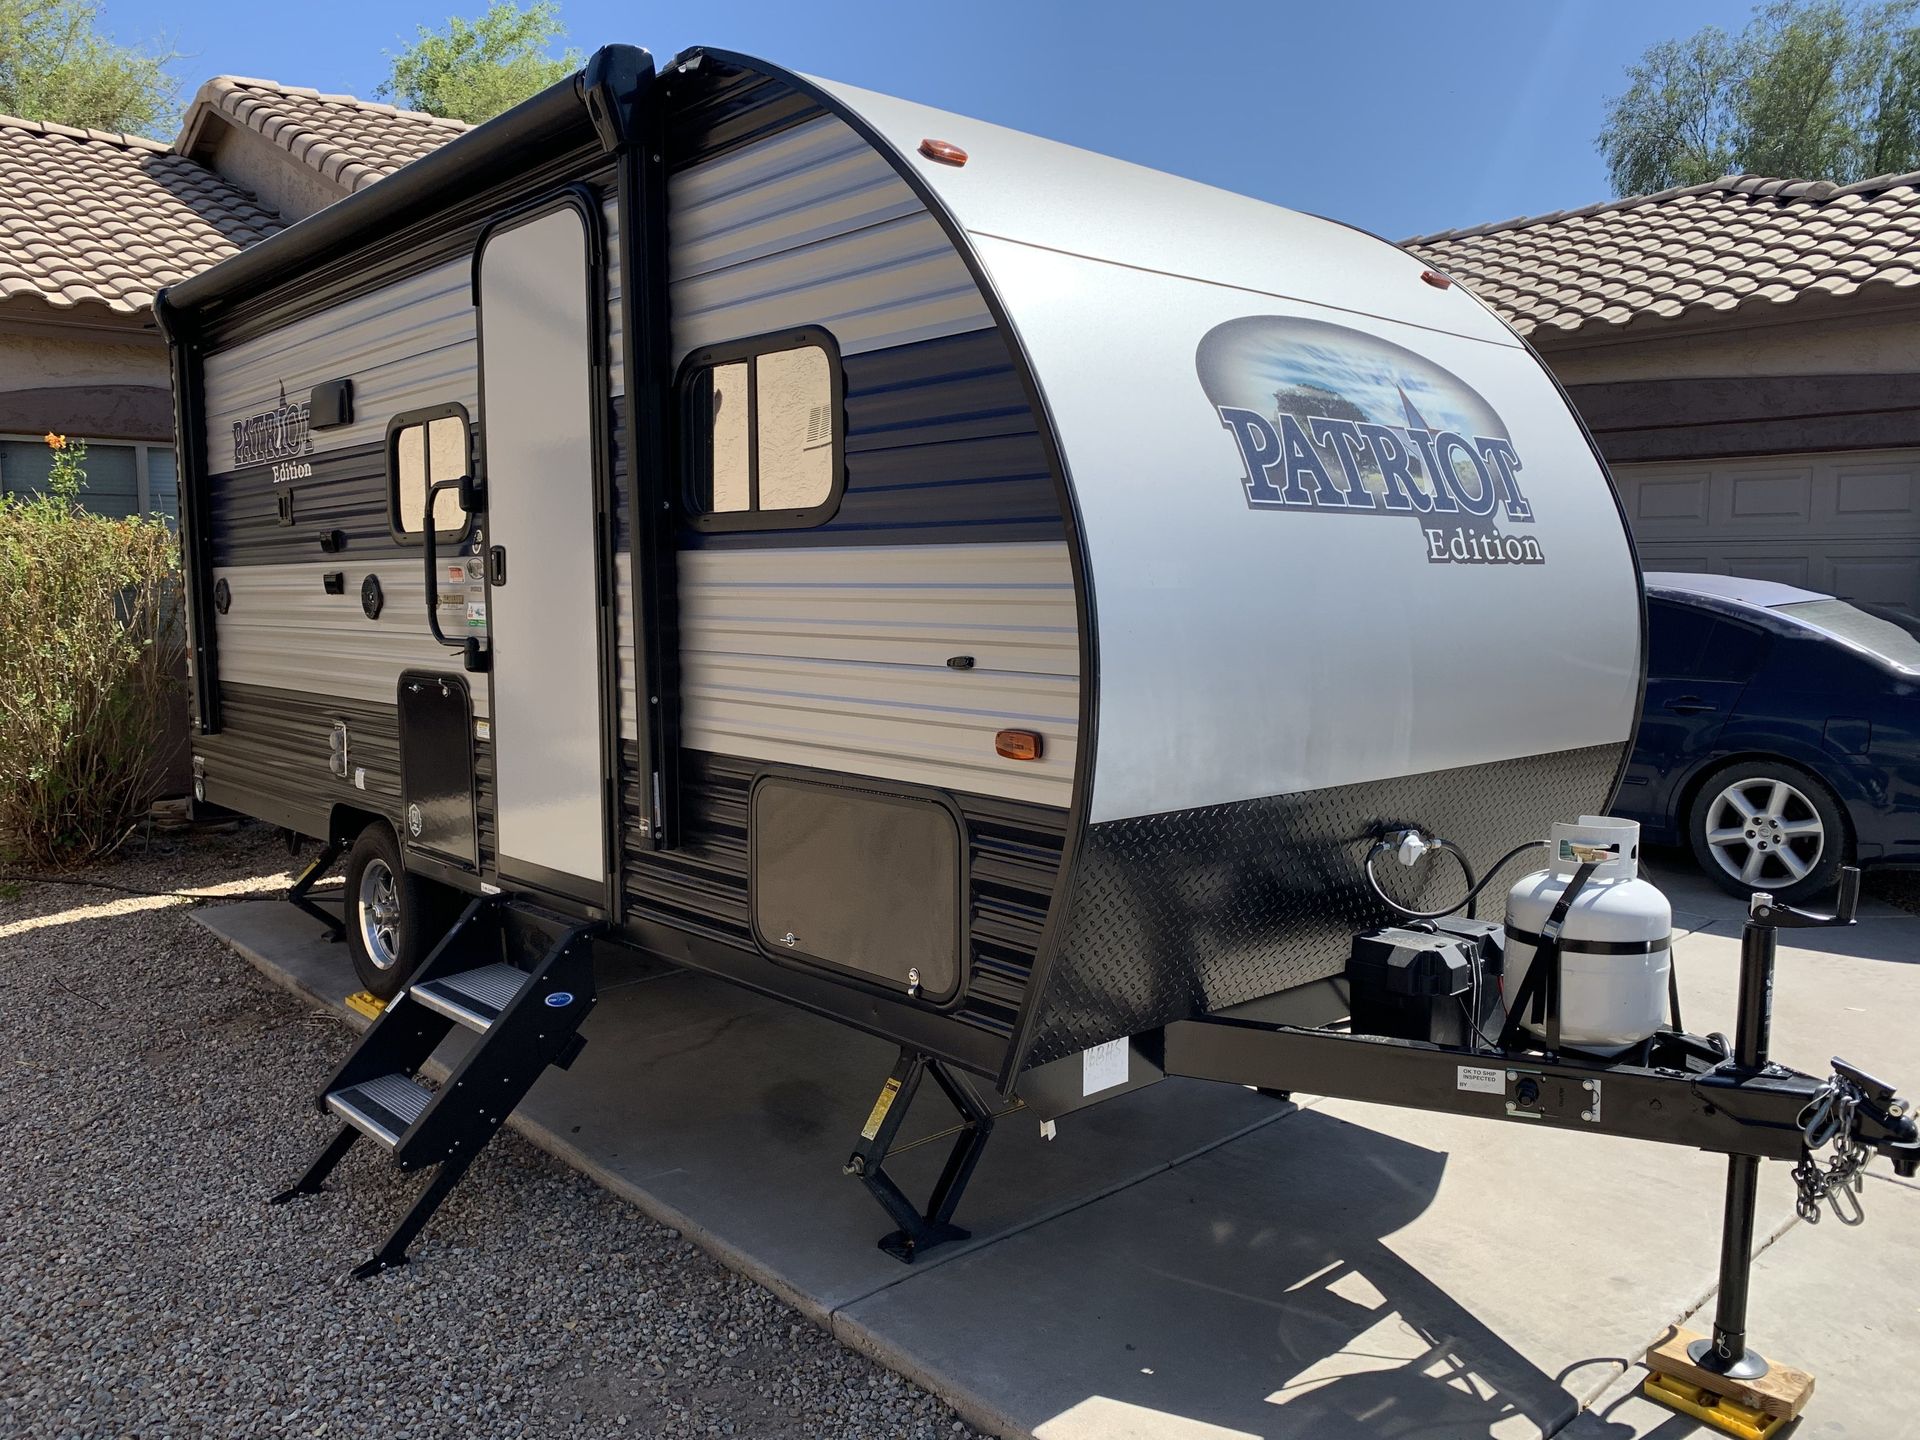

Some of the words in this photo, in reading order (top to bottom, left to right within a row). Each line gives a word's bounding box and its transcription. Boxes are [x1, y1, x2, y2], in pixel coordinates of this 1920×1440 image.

[272, 461, 312, 483] Edition
[1218, 405, 1532, 518] PATRIOT
[1425, 529, 1543, 562] Edition
